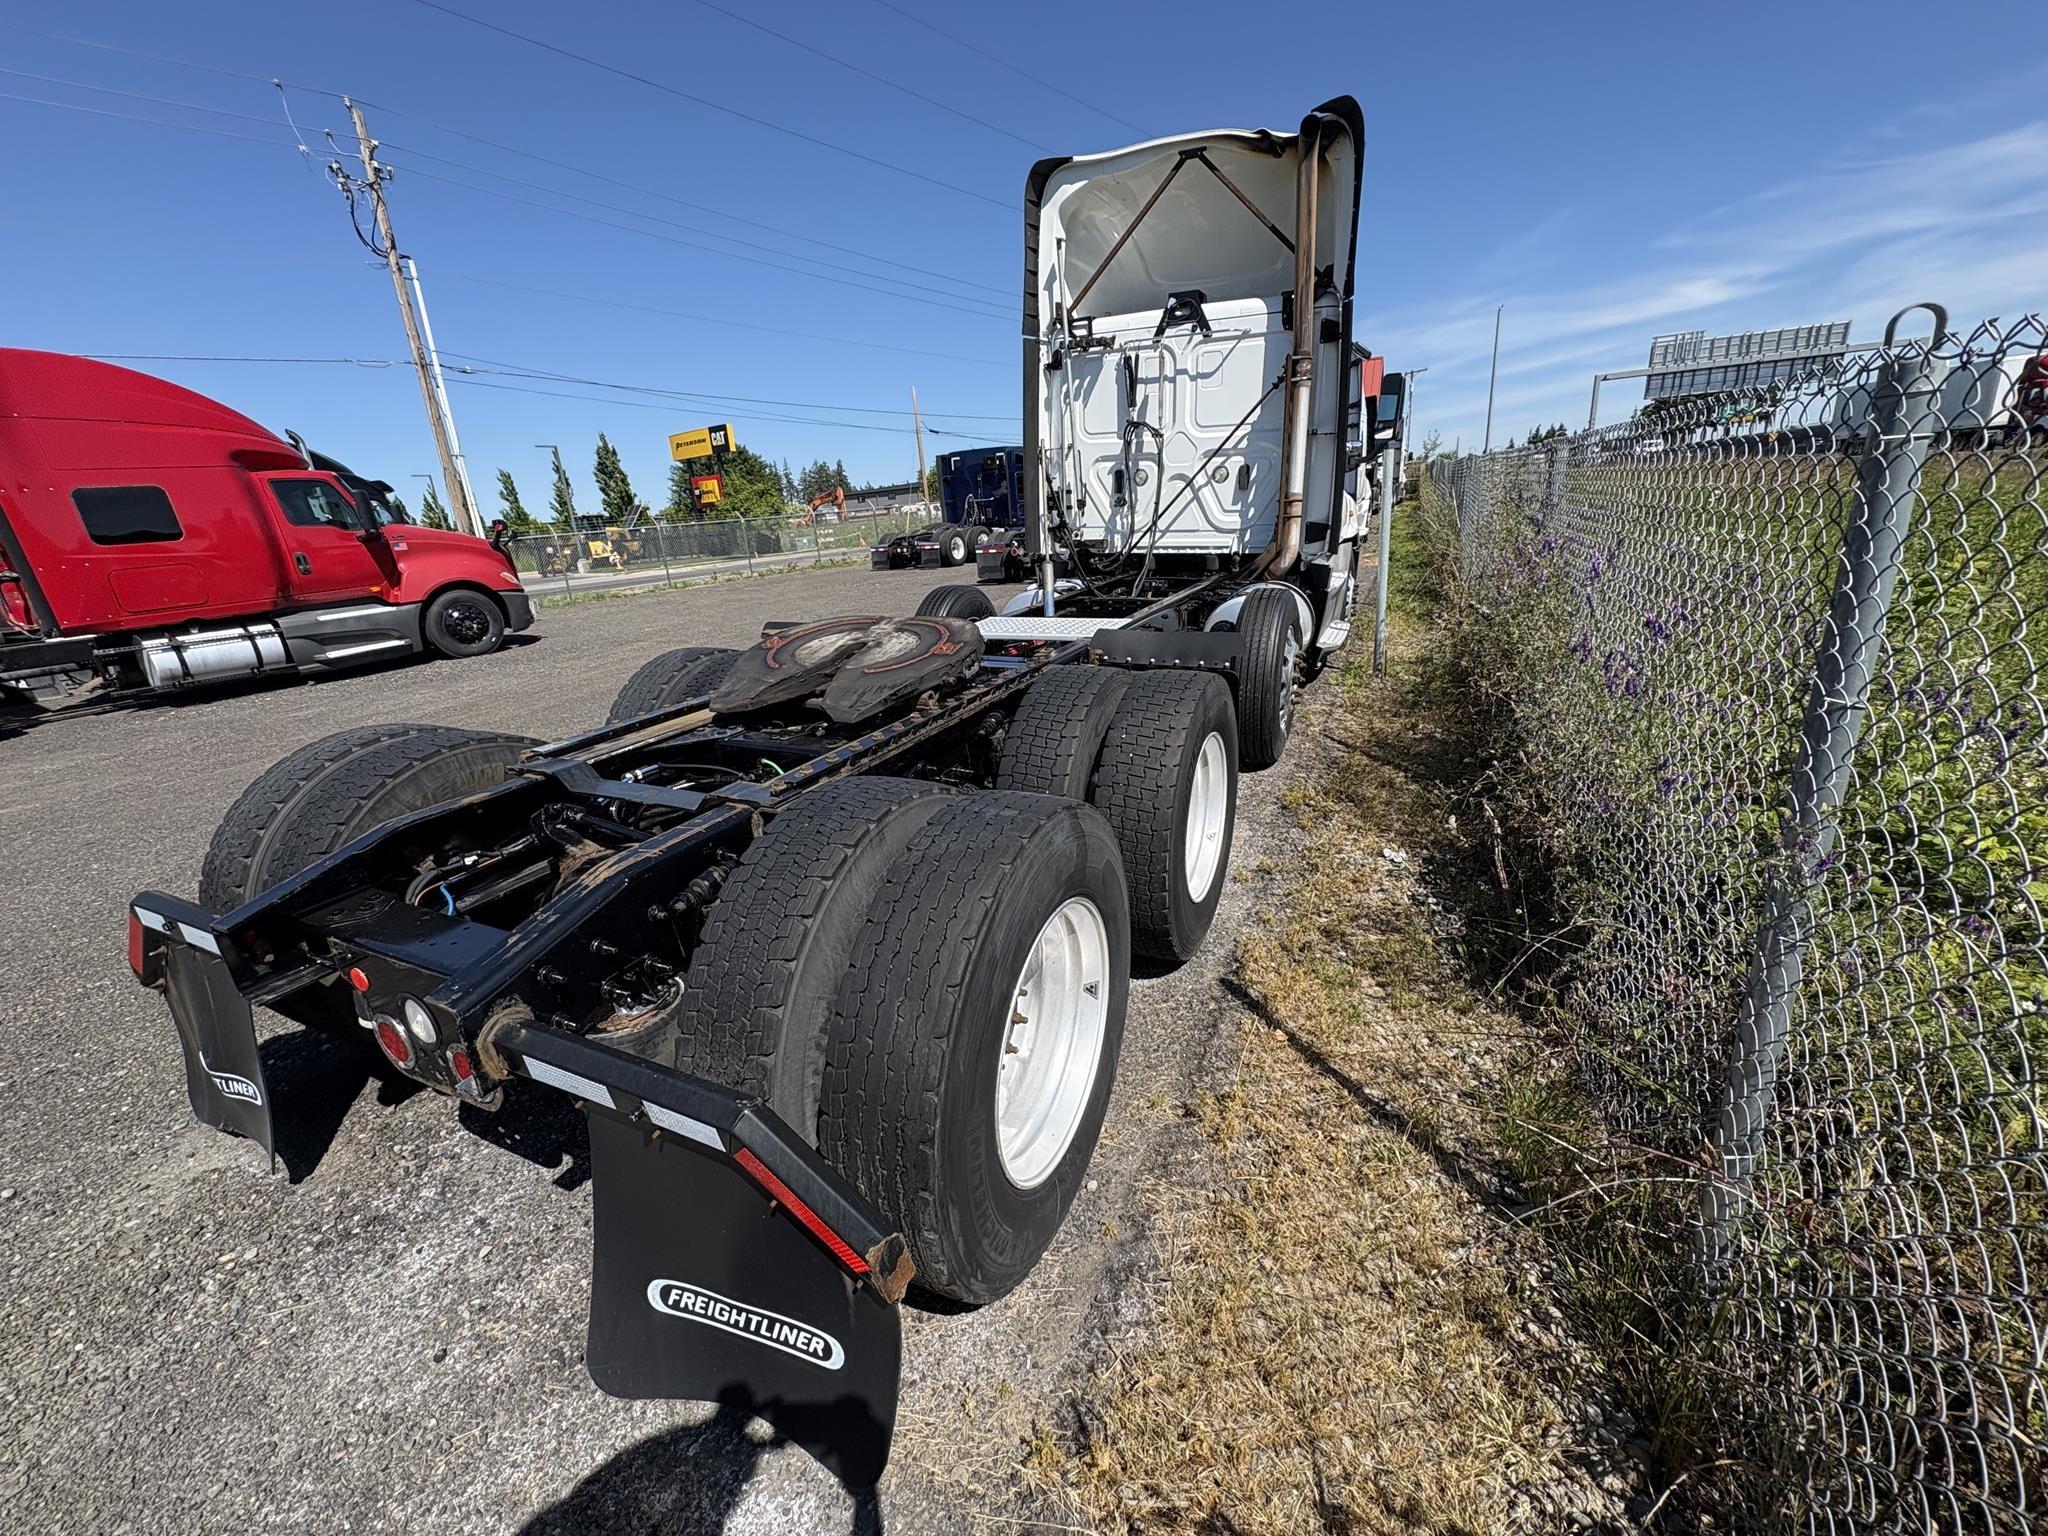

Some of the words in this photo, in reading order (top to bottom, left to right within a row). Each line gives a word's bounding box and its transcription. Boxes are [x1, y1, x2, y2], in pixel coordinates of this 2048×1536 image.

[676, 438, 706, 451] PETERSON
[711, 431, 725, 446] CAT
[667, 1288, 826, 1357] FREIGHTLINER
